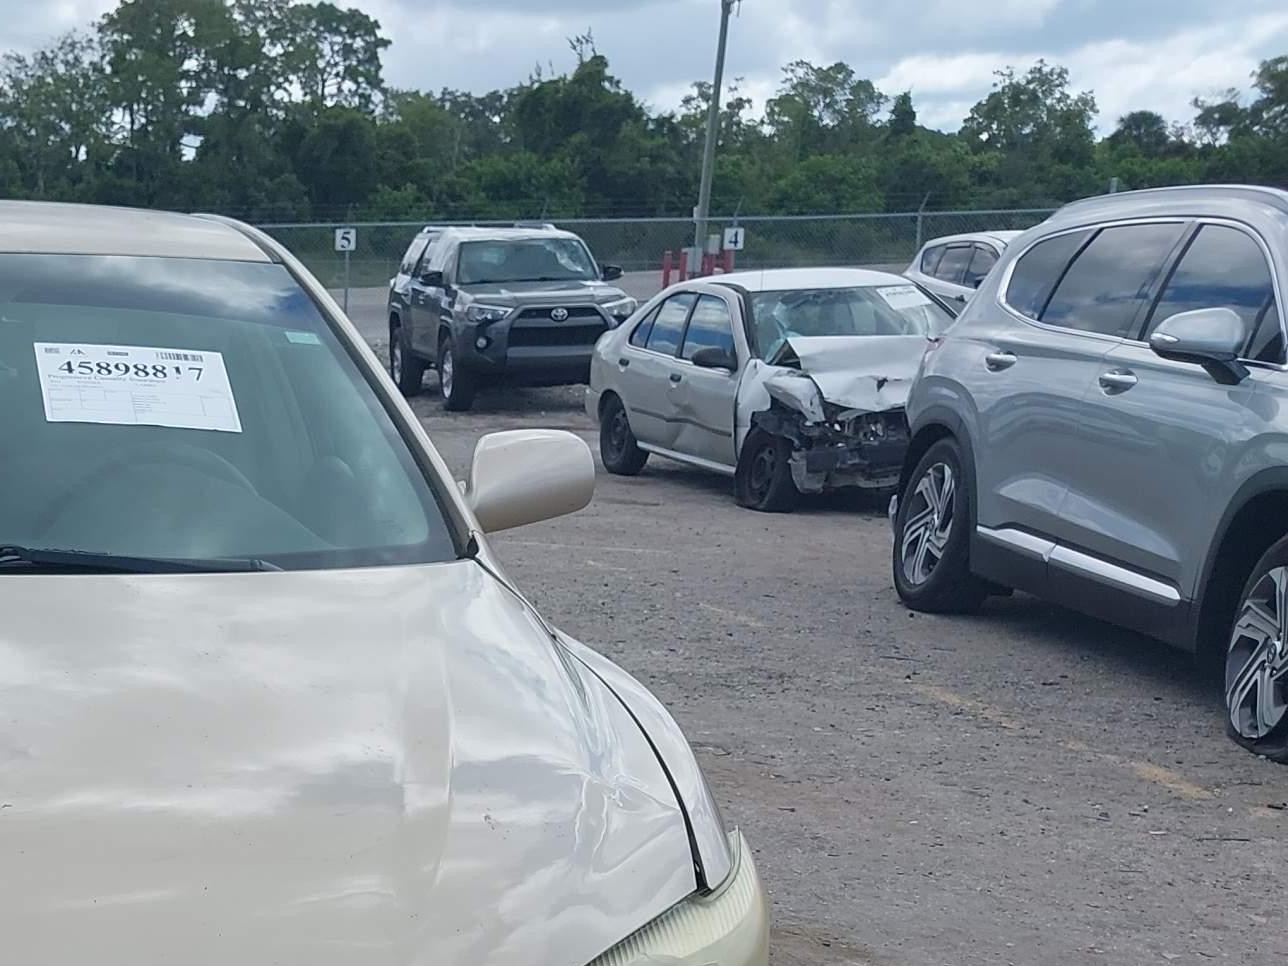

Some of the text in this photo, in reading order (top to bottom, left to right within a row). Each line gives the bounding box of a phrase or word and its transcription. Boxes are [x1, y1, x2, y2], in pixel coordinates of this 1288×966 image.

[340, 231, 352, 249] 5
[728, 231, 739, 247] 4
[58, 360, 204, 381] 45898817
